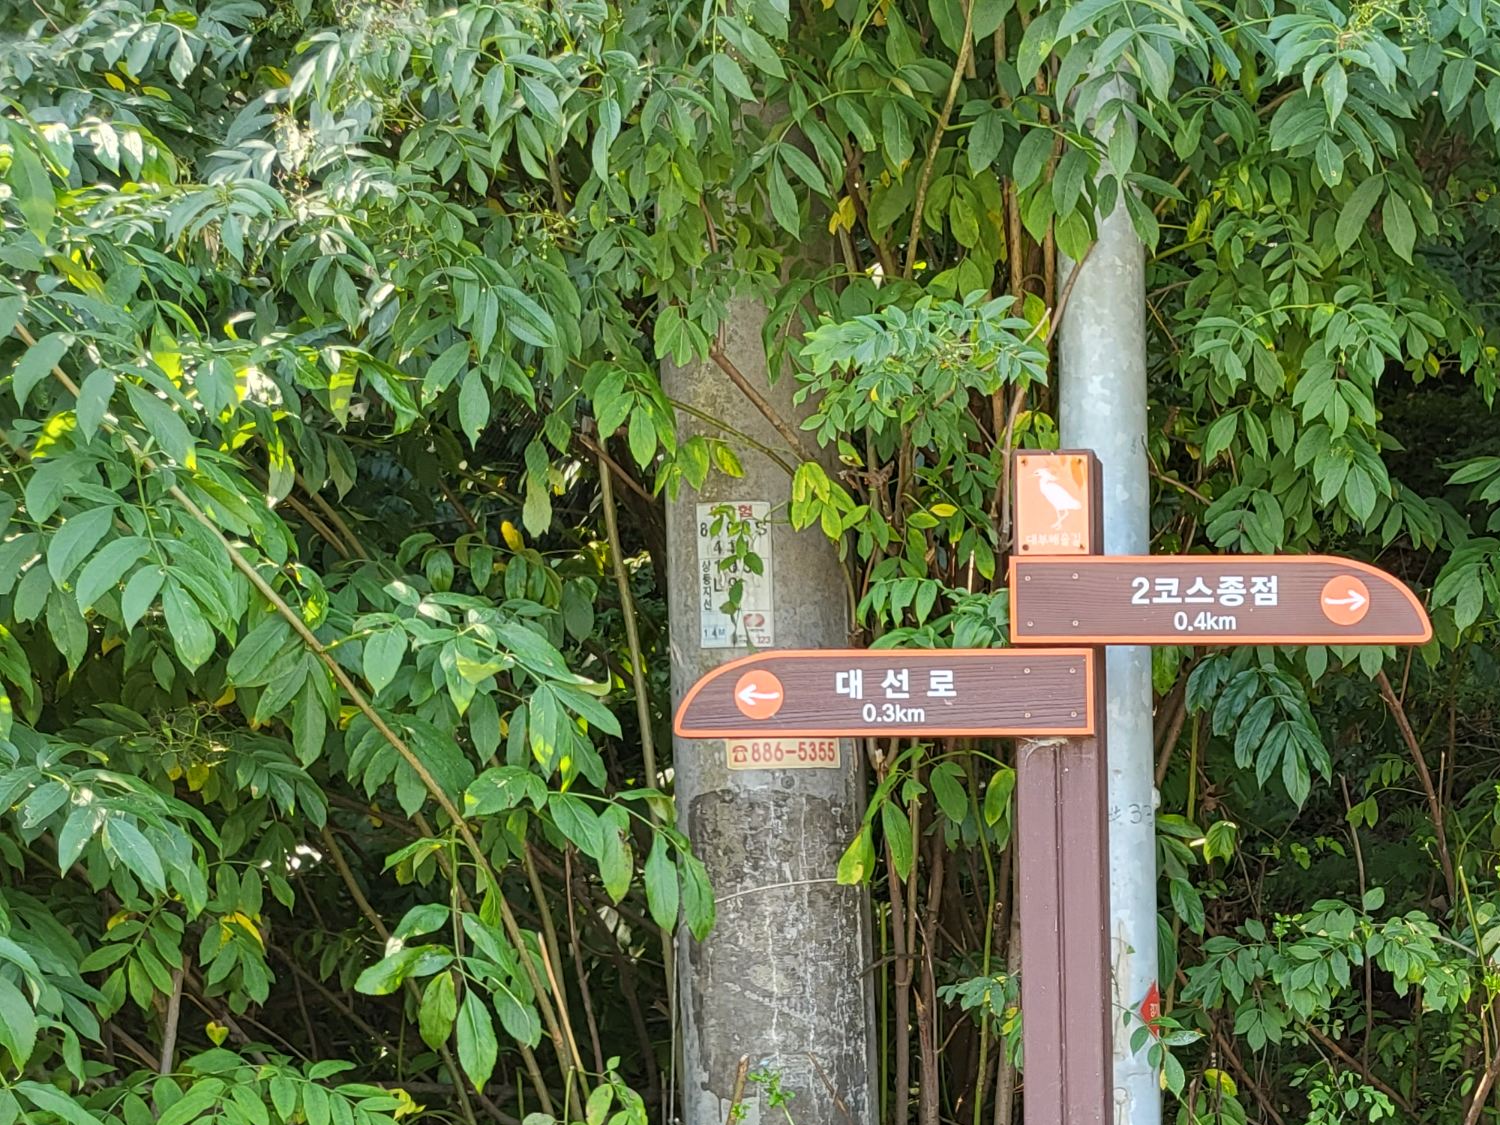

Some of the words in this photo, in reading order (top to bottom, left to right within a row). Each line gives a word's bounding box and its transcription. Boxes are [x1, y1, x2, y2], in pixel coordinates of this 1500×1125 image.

[1131, 575, 1279, 607] 2코스종점
[1174, 611, 1237, 632] 0.4km
[863, 703, 925, 722] 0.3km
[751, 742, 836, 763] 886-5355
